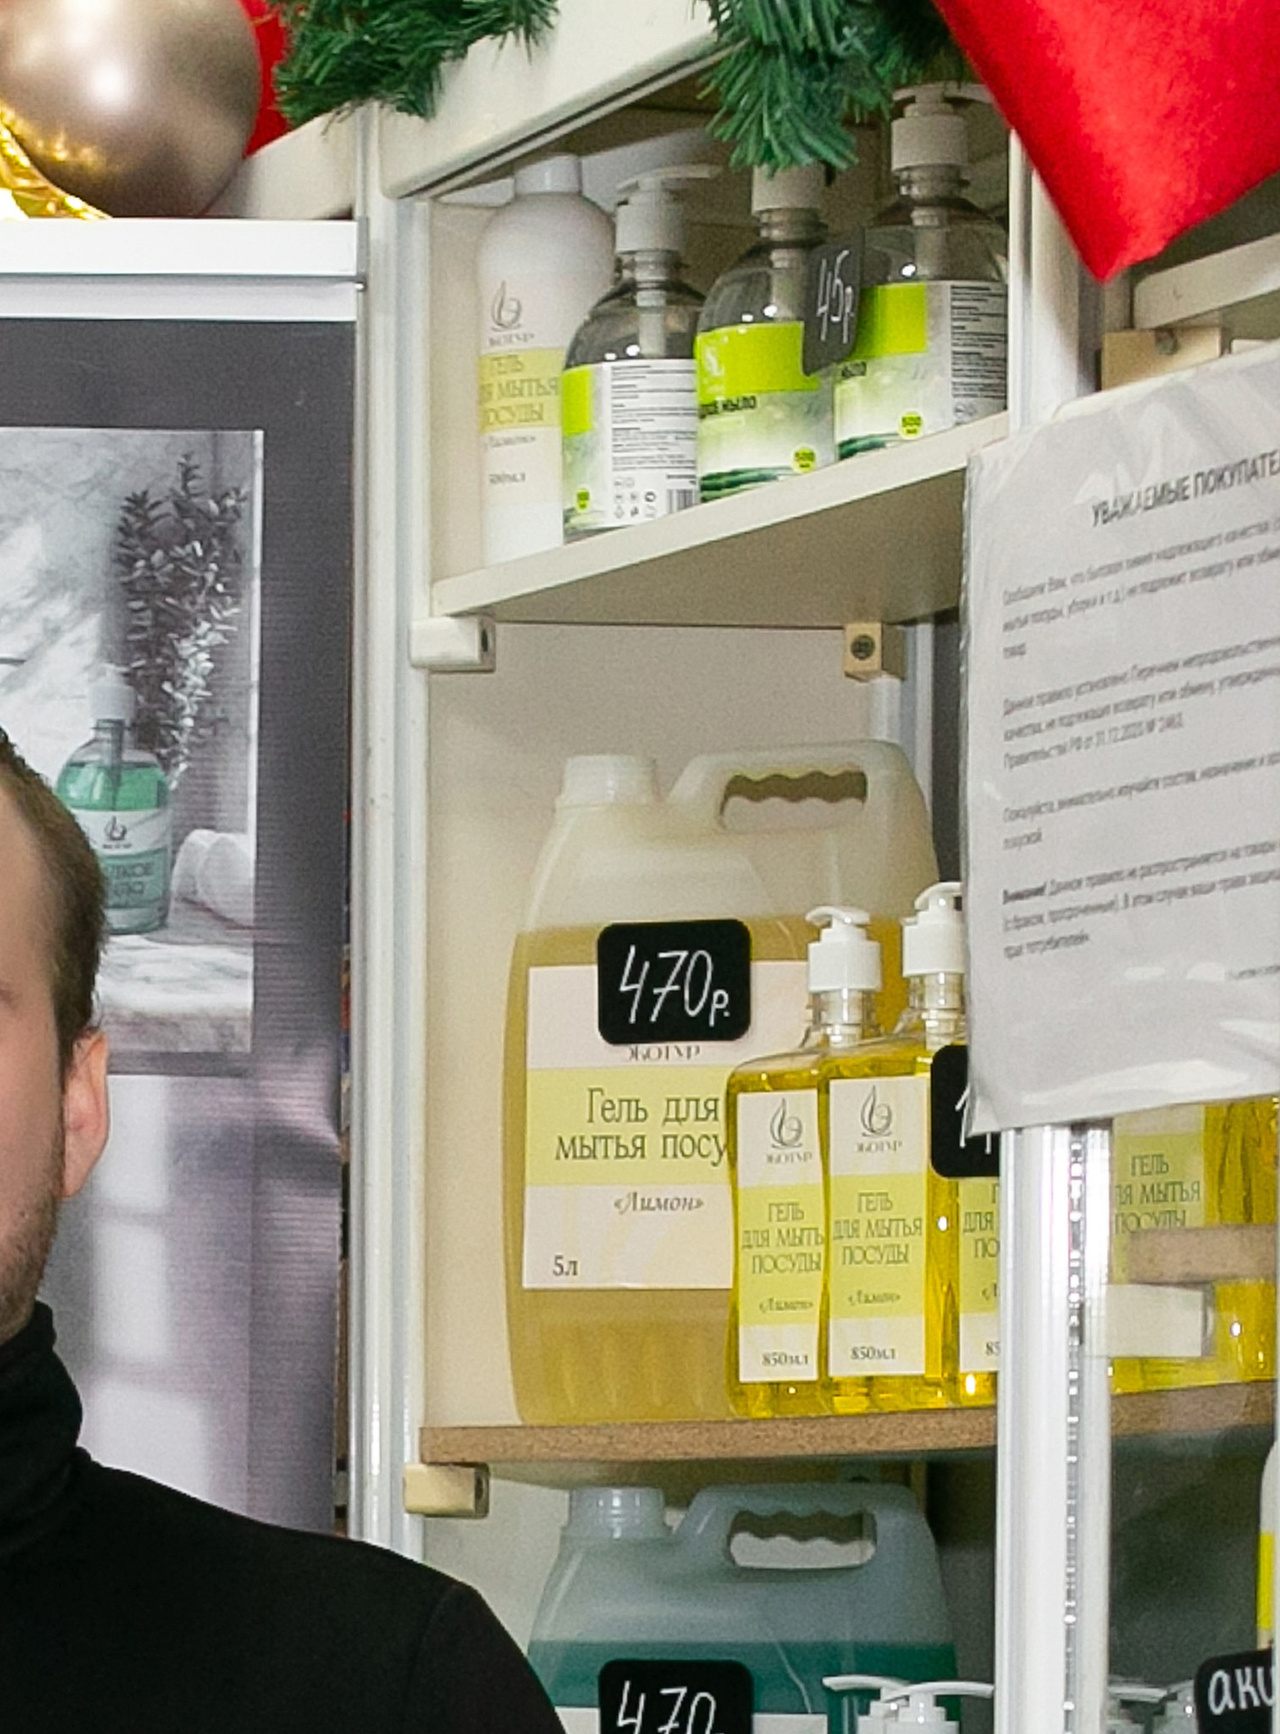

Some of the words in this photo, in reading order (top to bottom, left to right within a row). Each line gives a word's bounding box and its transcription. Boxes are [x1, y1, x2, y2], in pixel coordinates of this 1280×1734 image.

[1091, 475, 1190, 528] УВАЖАЕМЫЕ
[586, 1088, 648, 1124] Гель
[662, 1097, 720, 1126] для
[555, 1133, 647, 1161] мытья
[661, 1134, 726, 1167] посу
[1130, 1153, 1170, 1177] ГЕЛЬ
[857, 1191, 893, 1213] ГЕЛЬ
[1140, 1180, 1201, 1204] МЫТЬЯ
[768, 1202, 805, 1224] ГЕЛЬ
[741, 1228, 770, 1250] ДЛЯ
[775, 1226, 825, 1248] МЫТЬ
[832, 1219, 860, 1241] ДЛЯ
[865, 1217, 922, 1240] МЫТЬЯ
[551, 1255, 579, 1277] 5л
[751, 1251, 822, 1276] ПОСУДЫ
[842, 1243, 910, 1266] ПОСУДЫ
